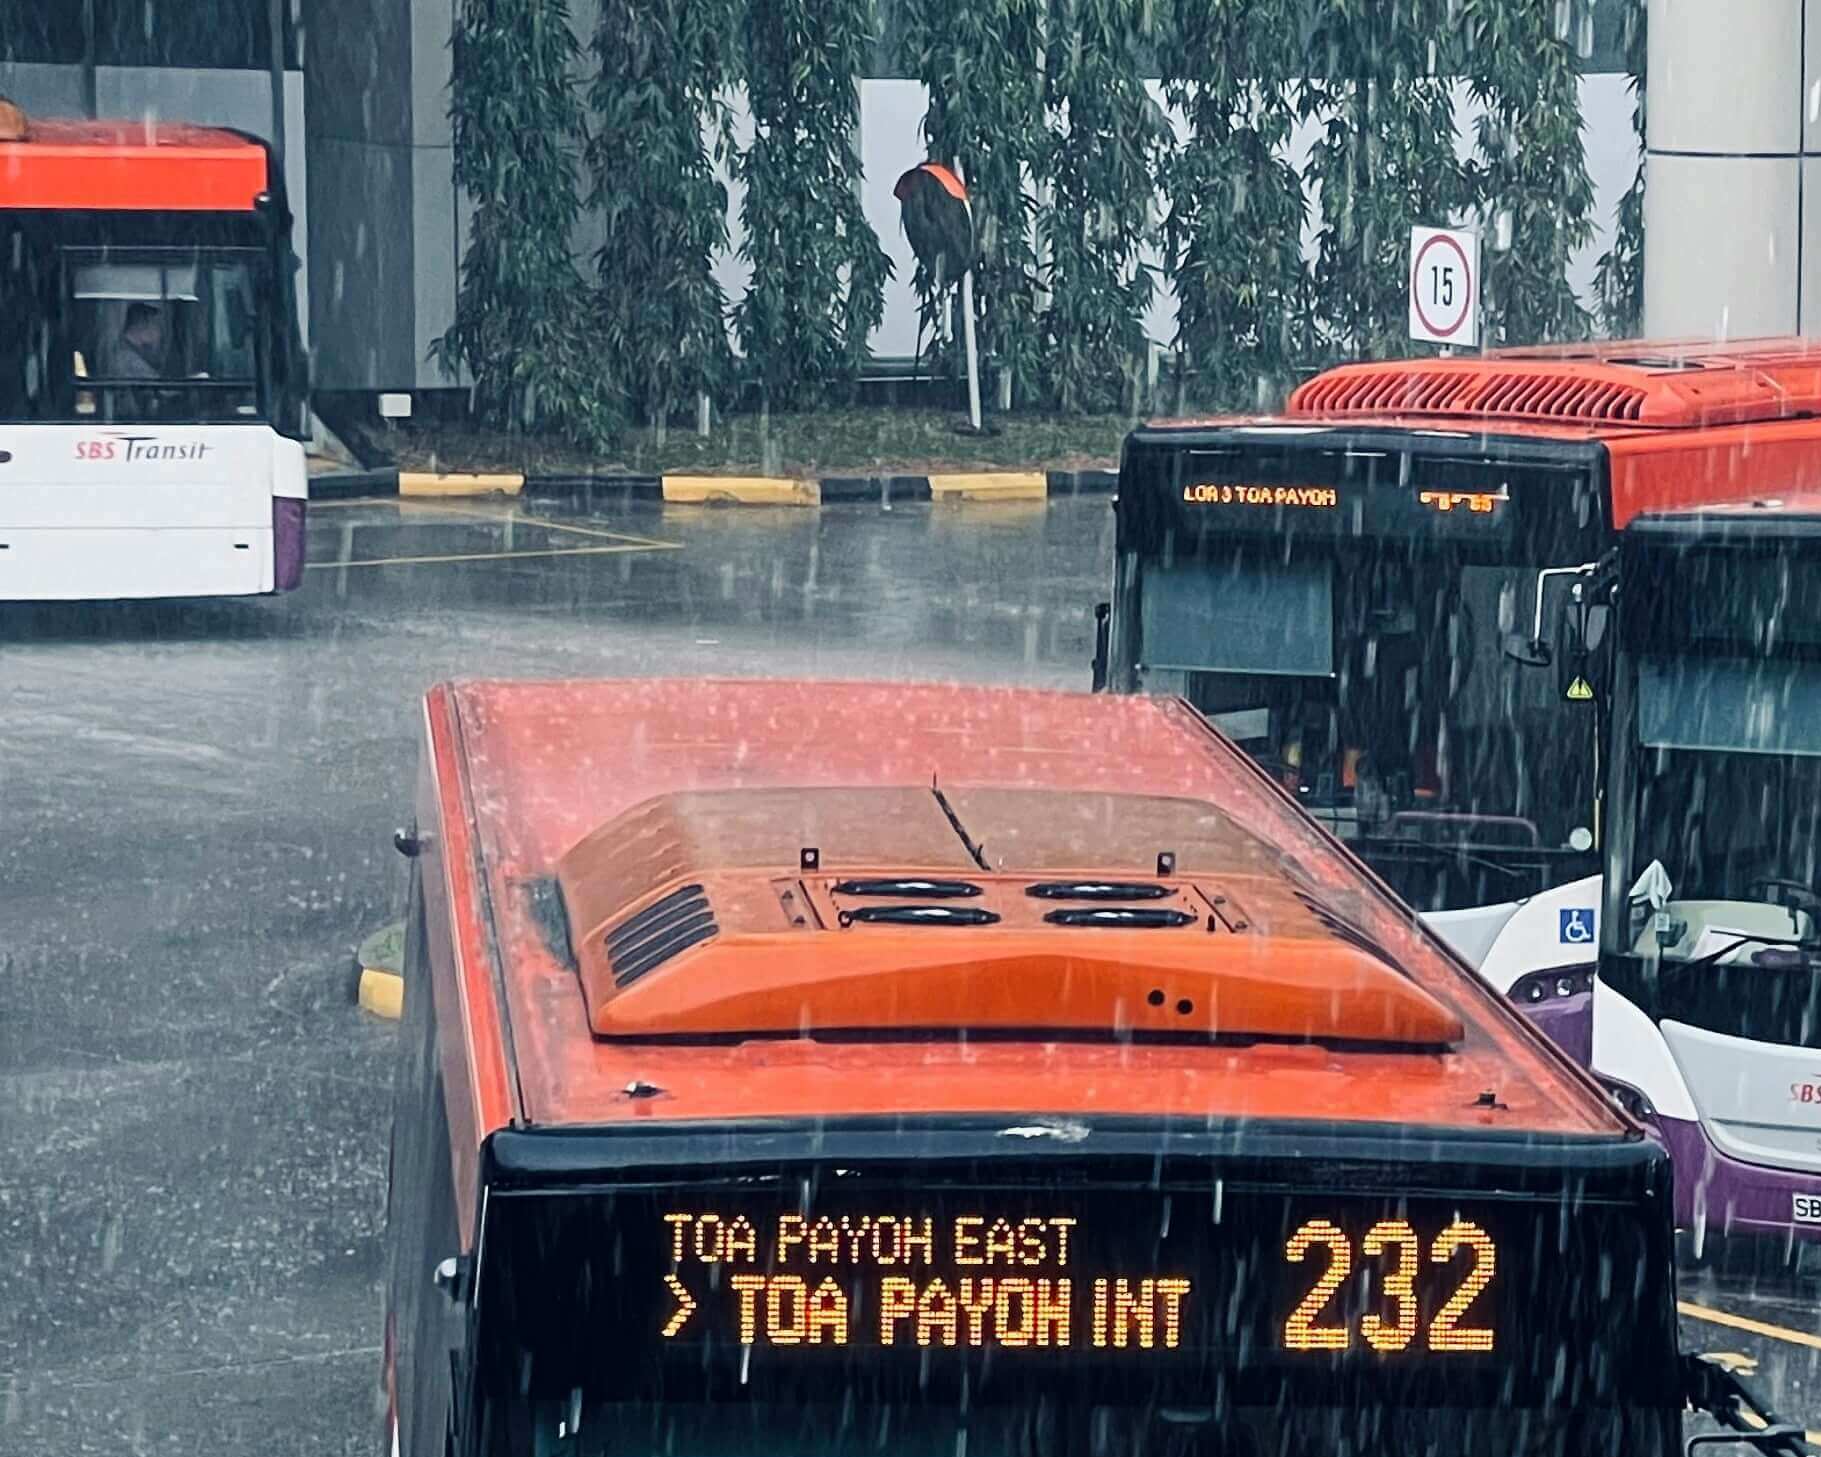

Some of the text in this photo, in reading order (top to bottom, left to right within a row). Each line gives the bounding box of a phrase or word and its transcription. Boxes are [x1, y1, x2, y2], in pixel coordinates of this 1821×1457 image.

[1432, 265, 1454, 306] 15
[75, 437, 215, 462] SBS Transit
[1235, 485, 1273, 504] TOA
[1274, 487, 1337, 507] PAYOH
[664, 1214, 1077, 1265] TOA PAYOH EAST
[1285, 1220, 1496, 1351] 232
[731, 1275, 848, 1345] TOA
[881, 1276, 1072, 1346] PAYOH
[1093, 1278, 1191, 1347] INT
